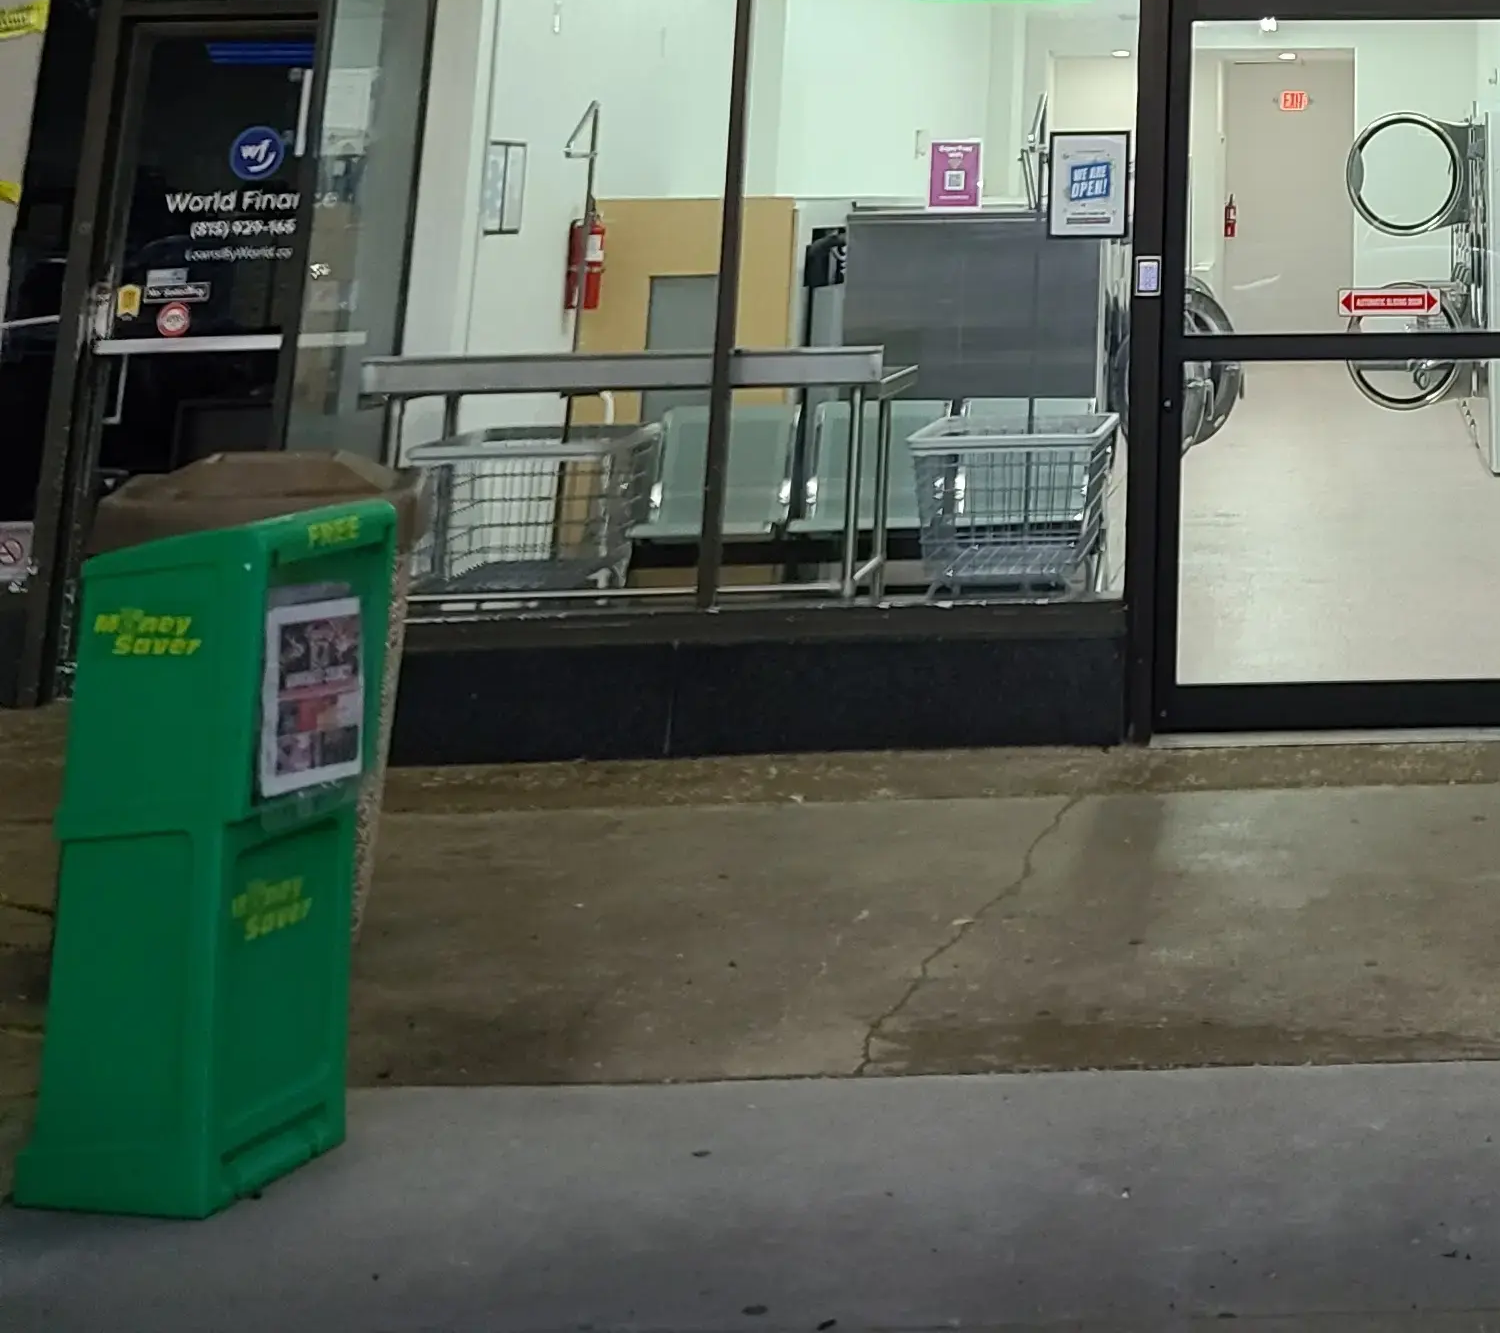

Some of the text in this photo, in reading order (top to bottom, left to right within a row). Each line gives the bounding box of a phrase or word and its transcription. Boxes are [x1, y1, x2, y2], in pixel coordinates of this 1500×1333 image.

[1283, 92, 1304, 109] EXIT
[1071, 178, 1108, 199] OPEN!
[165, 190, 239, 213] World
[307, 515, 360, 547] FREE
[111, 634, 202, 655] Saver
